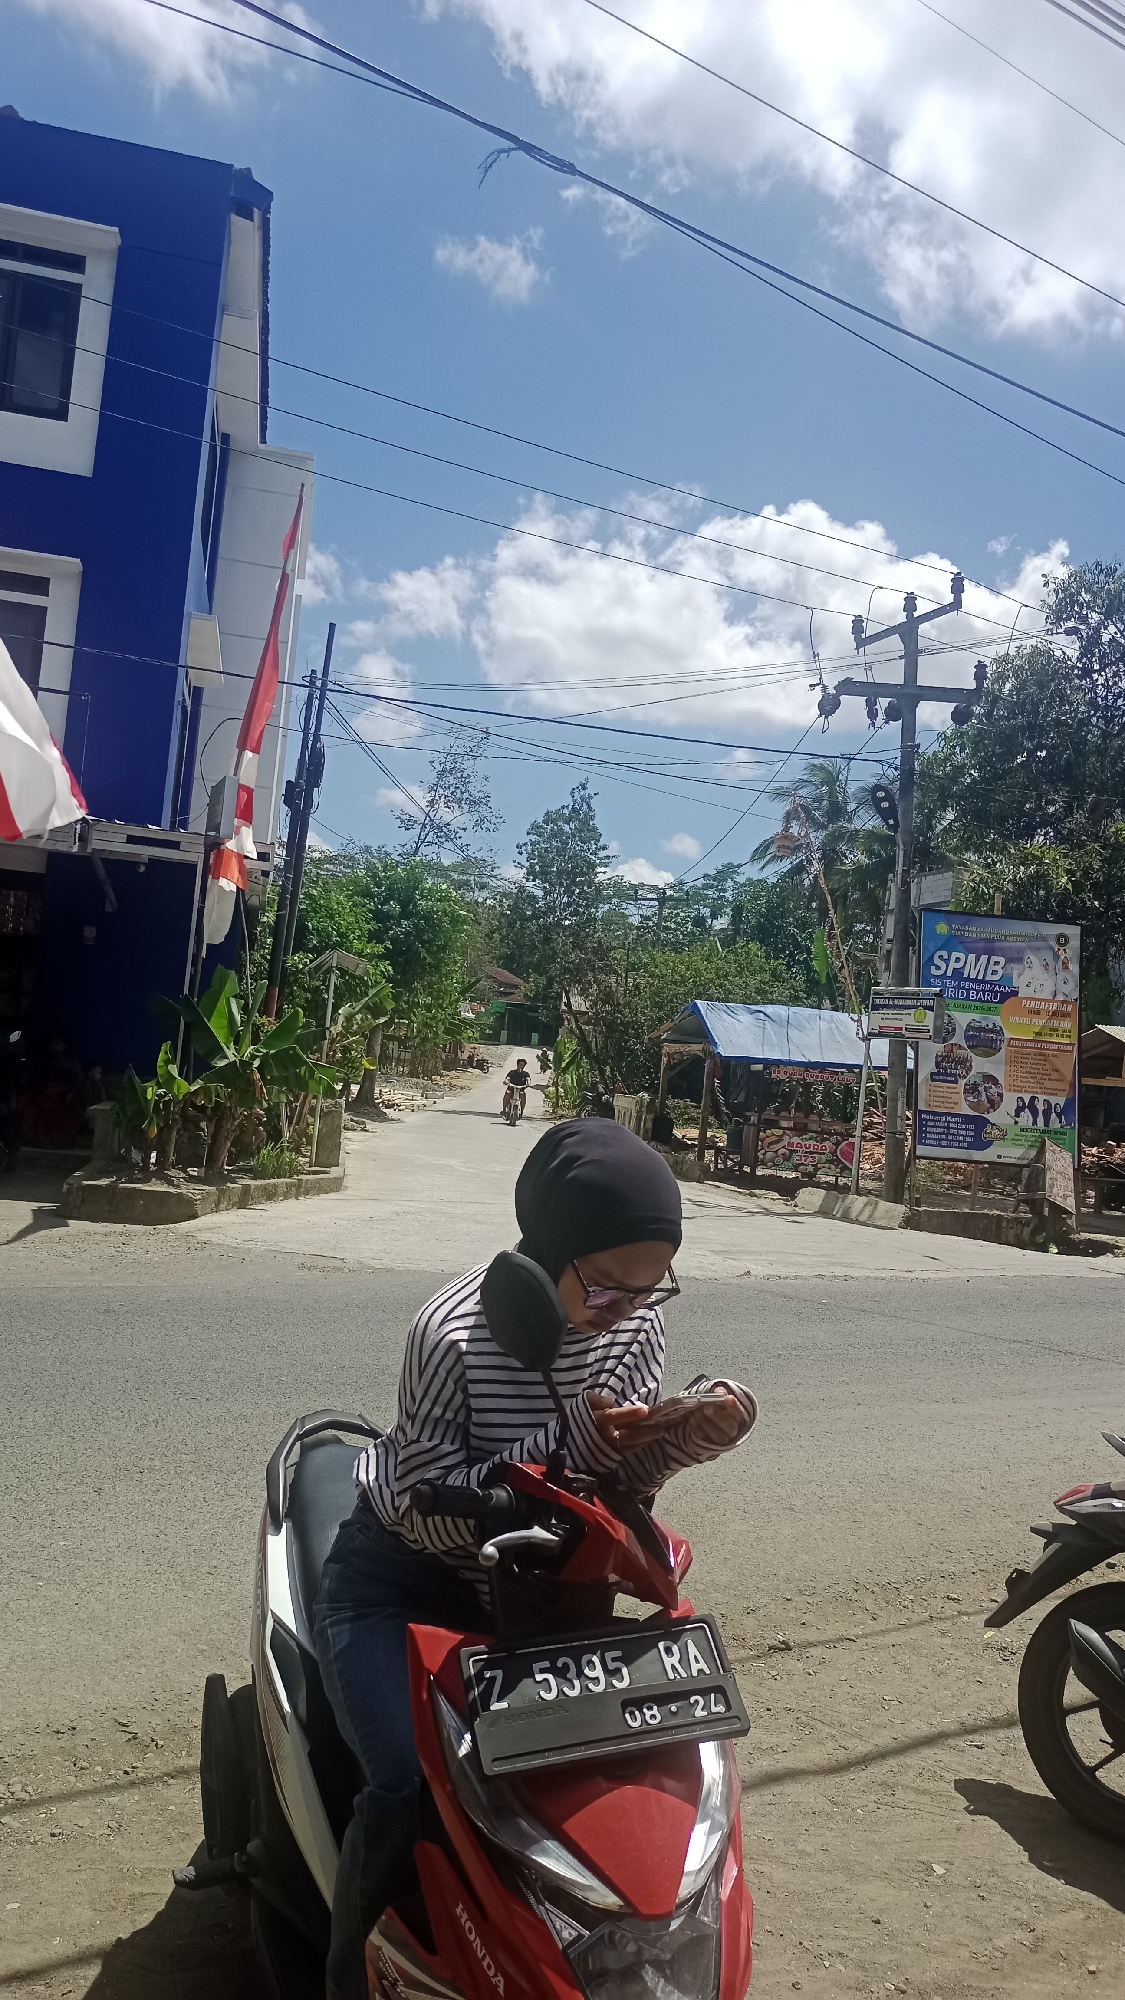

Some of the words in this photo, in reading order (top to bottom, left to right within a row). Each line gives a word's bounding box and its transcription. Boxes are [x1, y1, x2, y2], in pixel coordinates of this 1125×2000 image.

[930, 950, 1006, 981] SPMB
[930, 978, 958, 987] SISTEM
[960, 981, 1012, 993] PENERIMAAN
[934, 988, 967, 1000] URID
[969, 990, 1001, 1002] BARU
[1021, 1000, 1073, 1012] PENDAFTARAN
[786, 1141, 829, 1152] NAURA
[795, 1154, 818, 1164] 373
[483, 1669, 510, 1711] Z
[532, 1650, 631, 1701] 5395
[657, 1639, 711, 1680] RA
[501, 1705, 569, 1726] HONDA
[624, 1702, 662, 1728] 08
[689, 1692, 726, 1717] 24
[455, 1901, 506, 1997] HONDA
